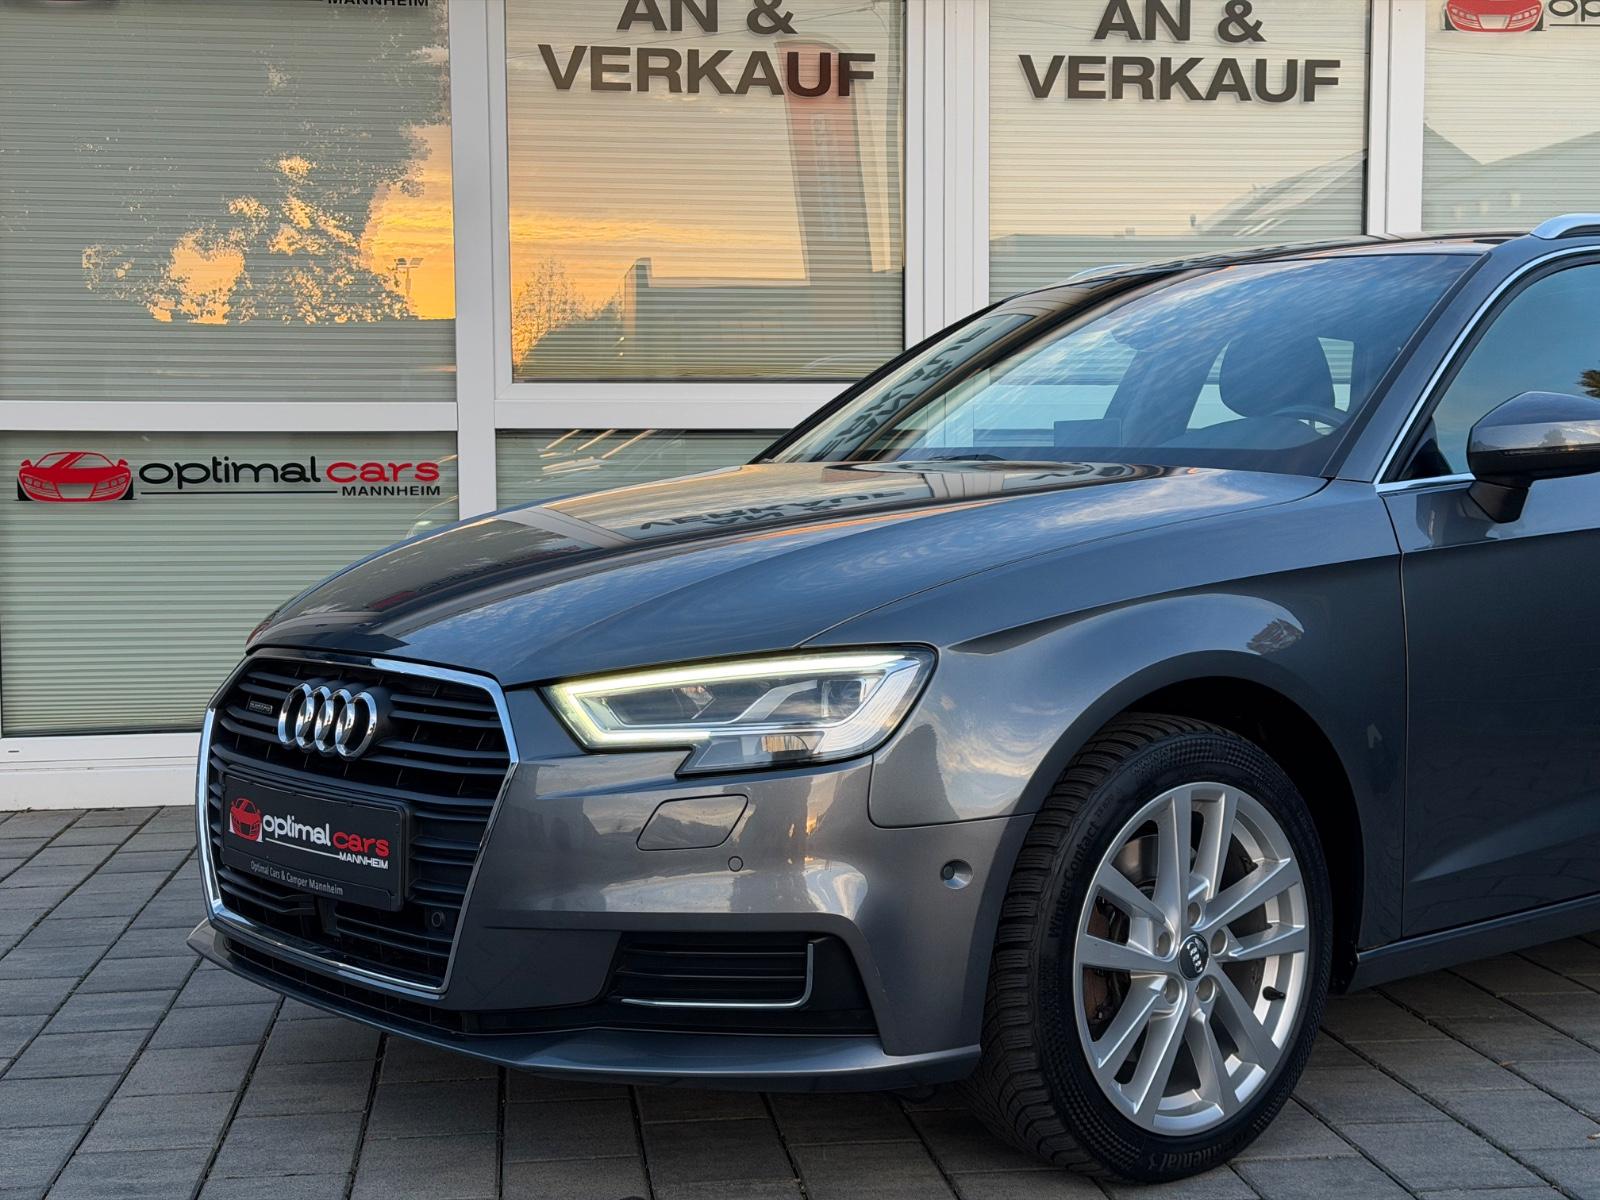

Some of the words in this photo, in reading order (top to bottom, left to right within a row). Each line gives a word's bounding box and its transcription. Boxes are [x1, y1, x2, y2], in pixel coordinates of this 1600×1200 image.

[616, 0, 718, 32] AN
[747, 0, 798, 34] &
[1093, 0, 1191, 41] AN
[1217, 0, 1267, 43] &
[538, 44, 876, 97] VERKAUF
[1018, 54, 1341, 103] VERKAUF
[139, 456, 321, 489] optimal
[326, 462, 440, 483] cars
[342, 485, 441, 497] MANNHEIM
[262, 814, 331, 847] optimal
[332, 831, 390, 857] cars
[250, 860, 269, 875] Optimal
[269, 867, 281, 879] Cars
[309, 879, 344, 896] Mannheim
[339, 851, 389, 870] MANNHEIM
